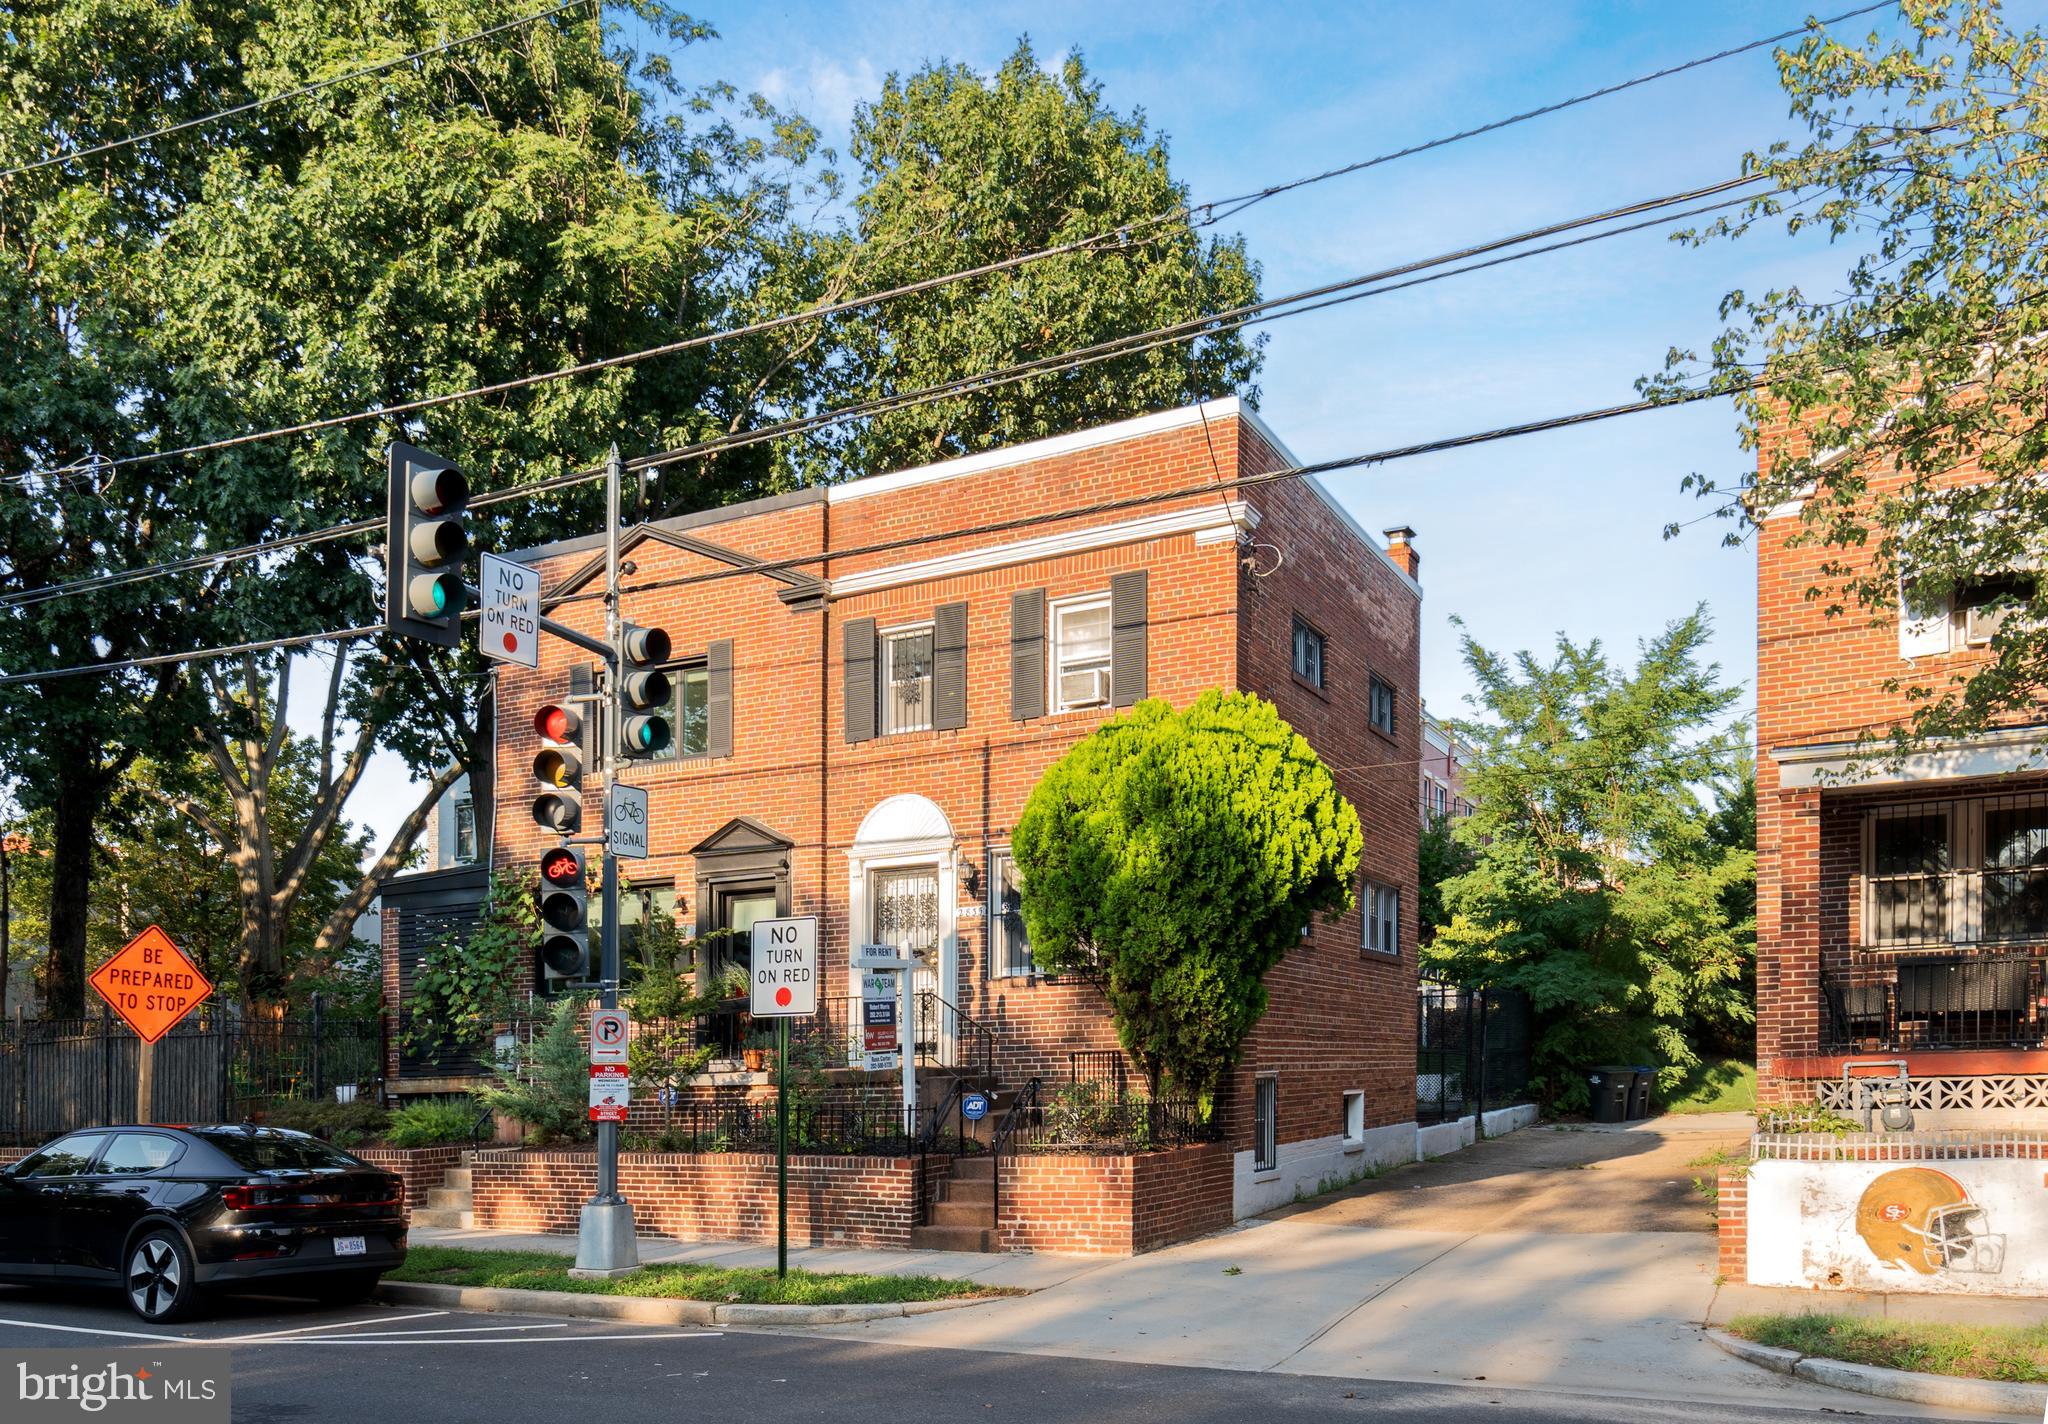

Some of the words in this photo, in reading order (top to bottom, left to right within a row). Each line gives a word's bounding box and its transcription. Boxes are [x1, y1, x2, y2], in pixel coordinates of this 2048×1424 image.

[500, 567, 523, 591] NO
[496, 589, 527, 613] TURN
[487, 607, 504, 625] ON
[510, 614, 533, 634] RED
[613, 830, 645, 848] SIGNAL
[771, 926, 797, 944] NO
[143, 948, 163, 965] BE
[766, 948, 802, 964] TURN
[865, 947, 877, 957] FOR
[878, 947, 892, 957] RENT
[110, 968, 193, 990] PREPARED
[758, 969, 776, 984] ON
[783, 968, 810, 983] RED
[881, 978, 895, 988] TEAM
[118, 992, 137, 1009] TO
[146, 994, 186, 1012] STOP
[966, 1101, 984, 1111] ADT
